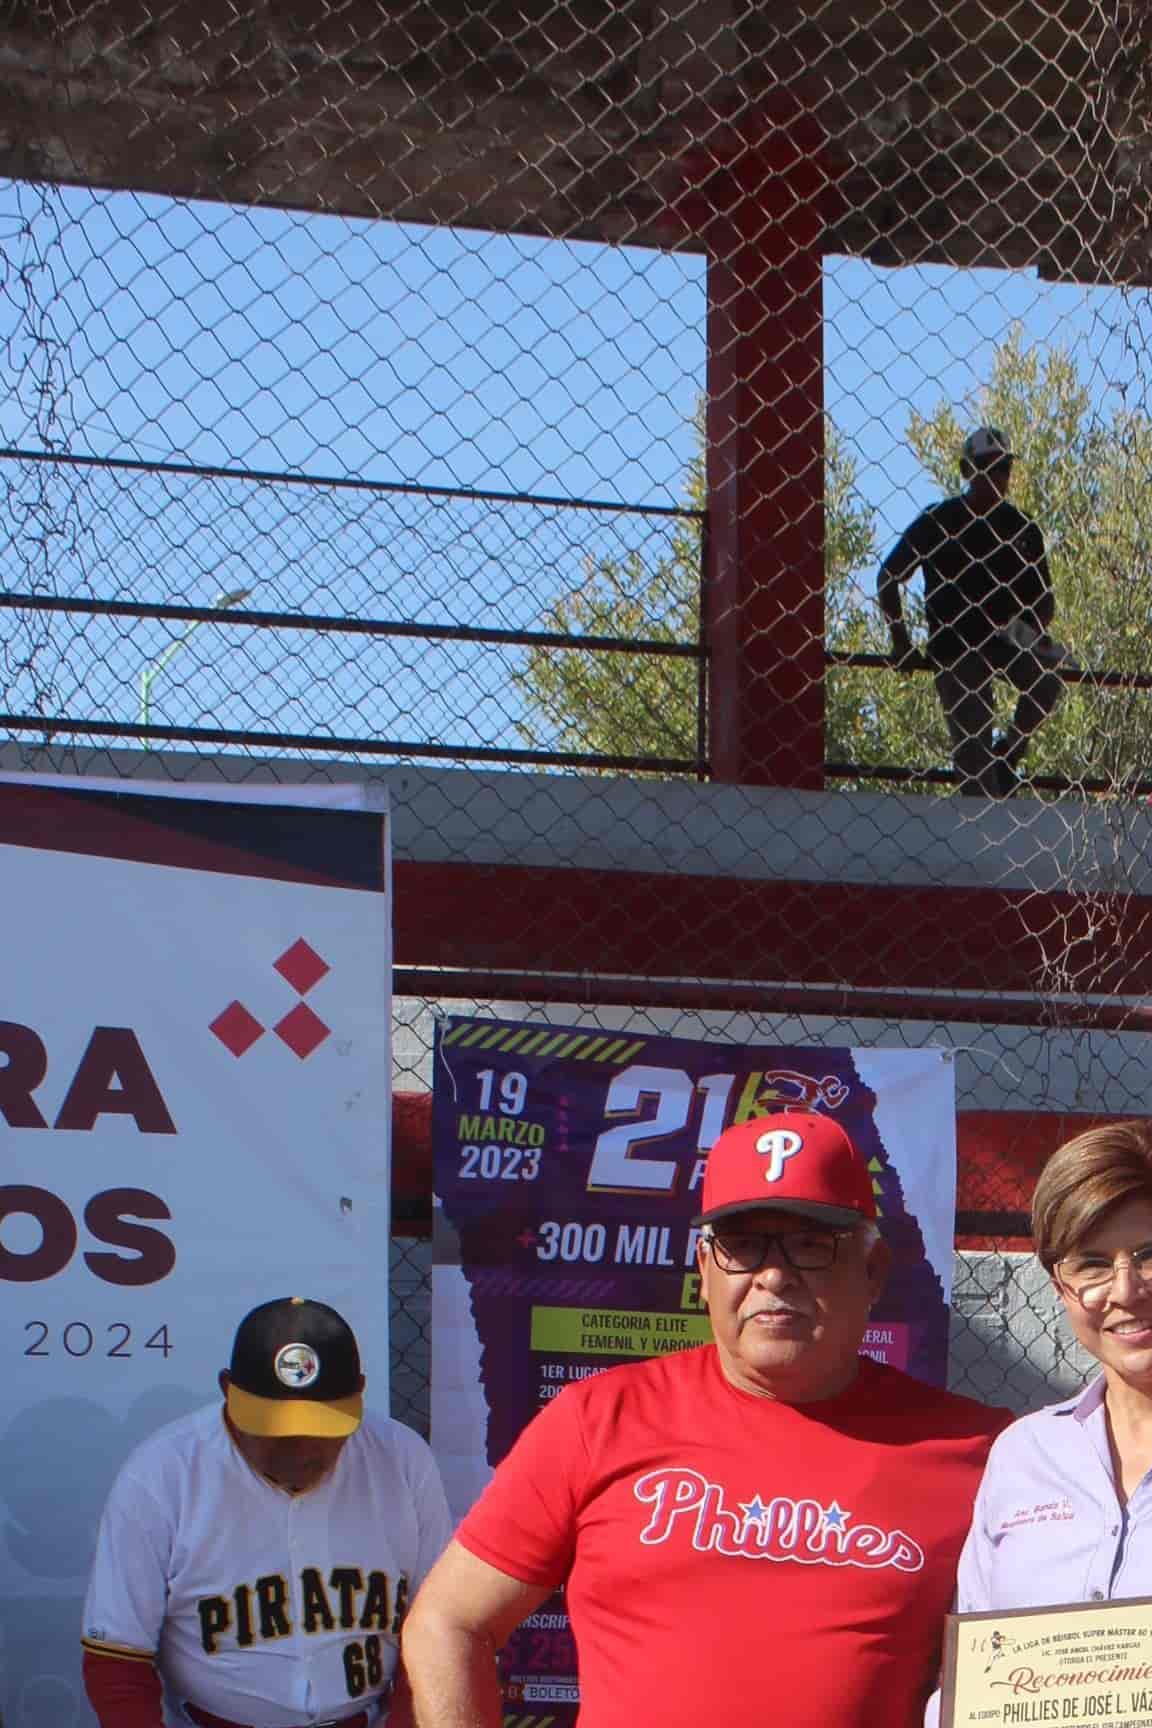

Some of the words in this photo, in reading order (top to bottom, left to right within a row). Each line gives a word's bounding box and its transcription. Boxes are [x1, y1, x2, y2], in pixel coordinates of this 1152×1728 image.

[476, 1069, 527, 1115] 19
[457, 1114, 545, 1146] MARZO
[458, 1145, 542, 1181] 2023
[755, 1128, 803, 1182] P
[614, 1225, 674, 1265] MIL
[23, 1321, 174, 1358] 2024
[582, 1313, 650, 1331] CATEGORIA
[655, 1318, 689, 1332] ELITE
[581, 1334, 634, 1350] FEMENIL
[640, 1338, 649, 1350] Y
[541, 1364, 564, 1379] 1ER
[633, 1467, 925, 1572] Phillies
[343, 1634, 383, 1698] 68
[1003, 1699, 1059, 1724] PHILLIES
[1063, 1697, 1079, 1718] DE
[1082, 1690, 1113, 1717] JOSÉ
[1116, 1693, 1128, 1714] L.
